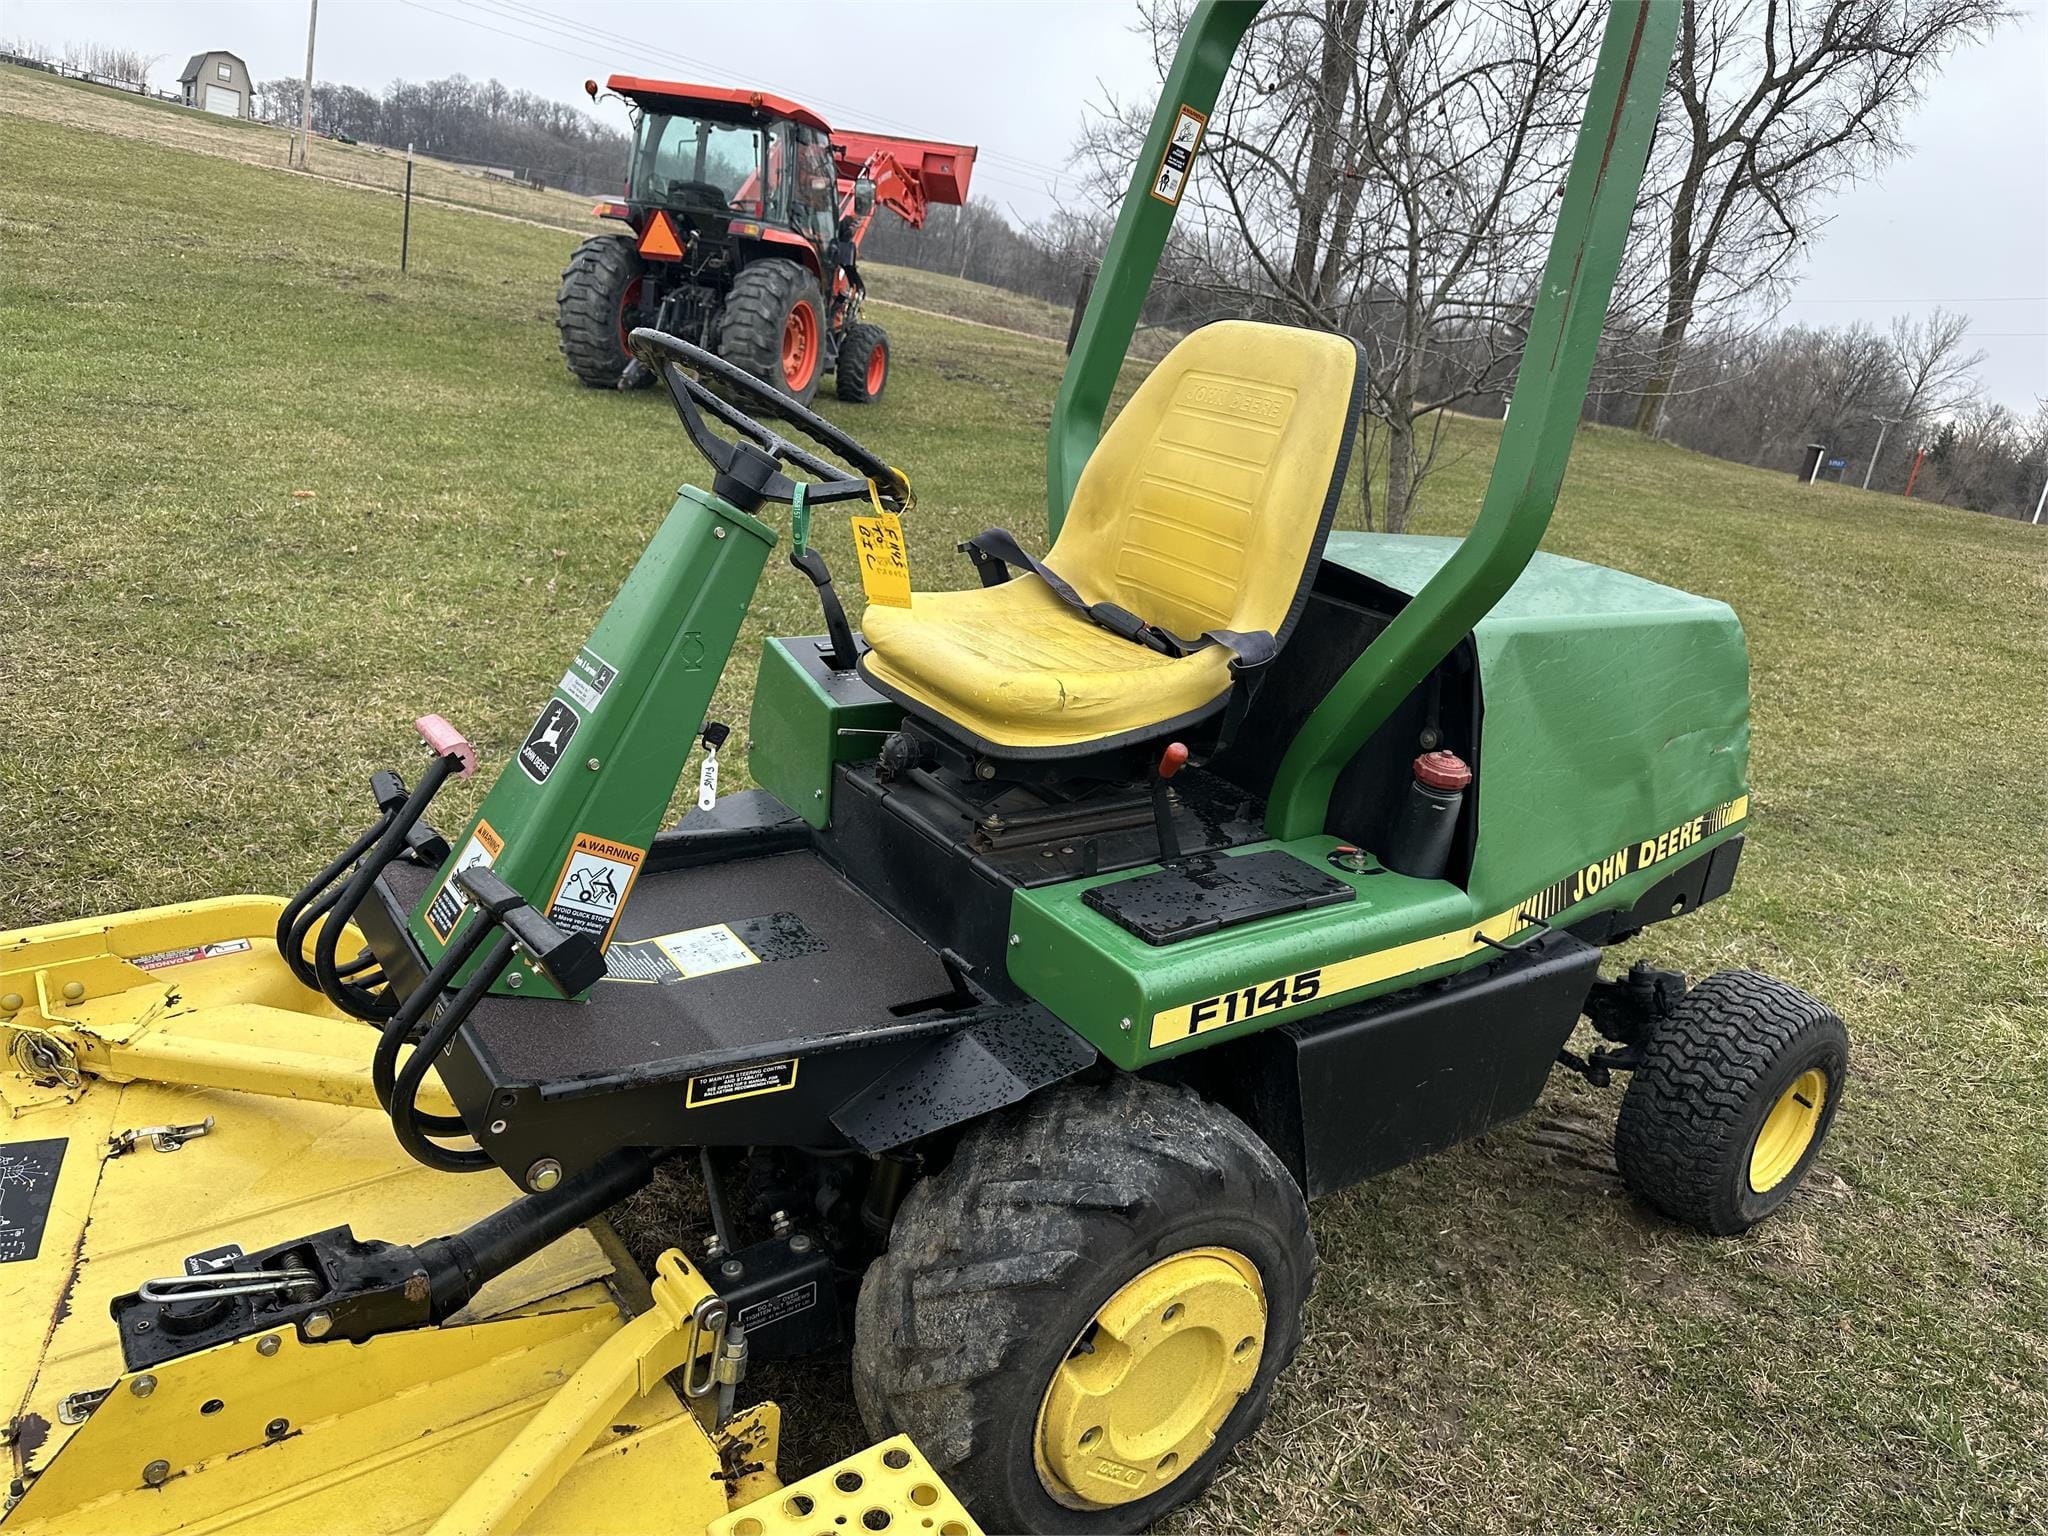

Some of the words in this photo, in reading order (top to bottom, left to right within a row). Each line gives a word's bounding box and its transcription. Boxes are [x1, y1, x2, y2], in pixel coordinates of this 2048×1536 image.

[1186, 384, 1228, 407] JOHN
[1229, 389, 1284, 418] DEERE
[522, 746, 537, 762] JOHN
[533, 755, 549, 776] DEERE
[589, 841, 640, 862] WARNING
[1573, 847, 1628, 902] JOHN
[1638, 815, 1704, 869] DEERE
[552, 906, 571, 915] AVOID
[572, 910, 590, 920] QUICK
[591, 914, 610, 924] STOPS
[558, 915, 573, 923] Move
[574, 918, 586, 926] very
[587, 921, 605, 930] slowly
[141, 957, 184, 970] DANGER
[1189, 969, 1321, 1034] F1145
[709, 1073, 735, 1083] MAINTAIN
[736, 1069, 762, 1078] STEERING
[763, 1064, 787, 1073] CONTROL
[736, 1073, 763, 1083] STABILITY
